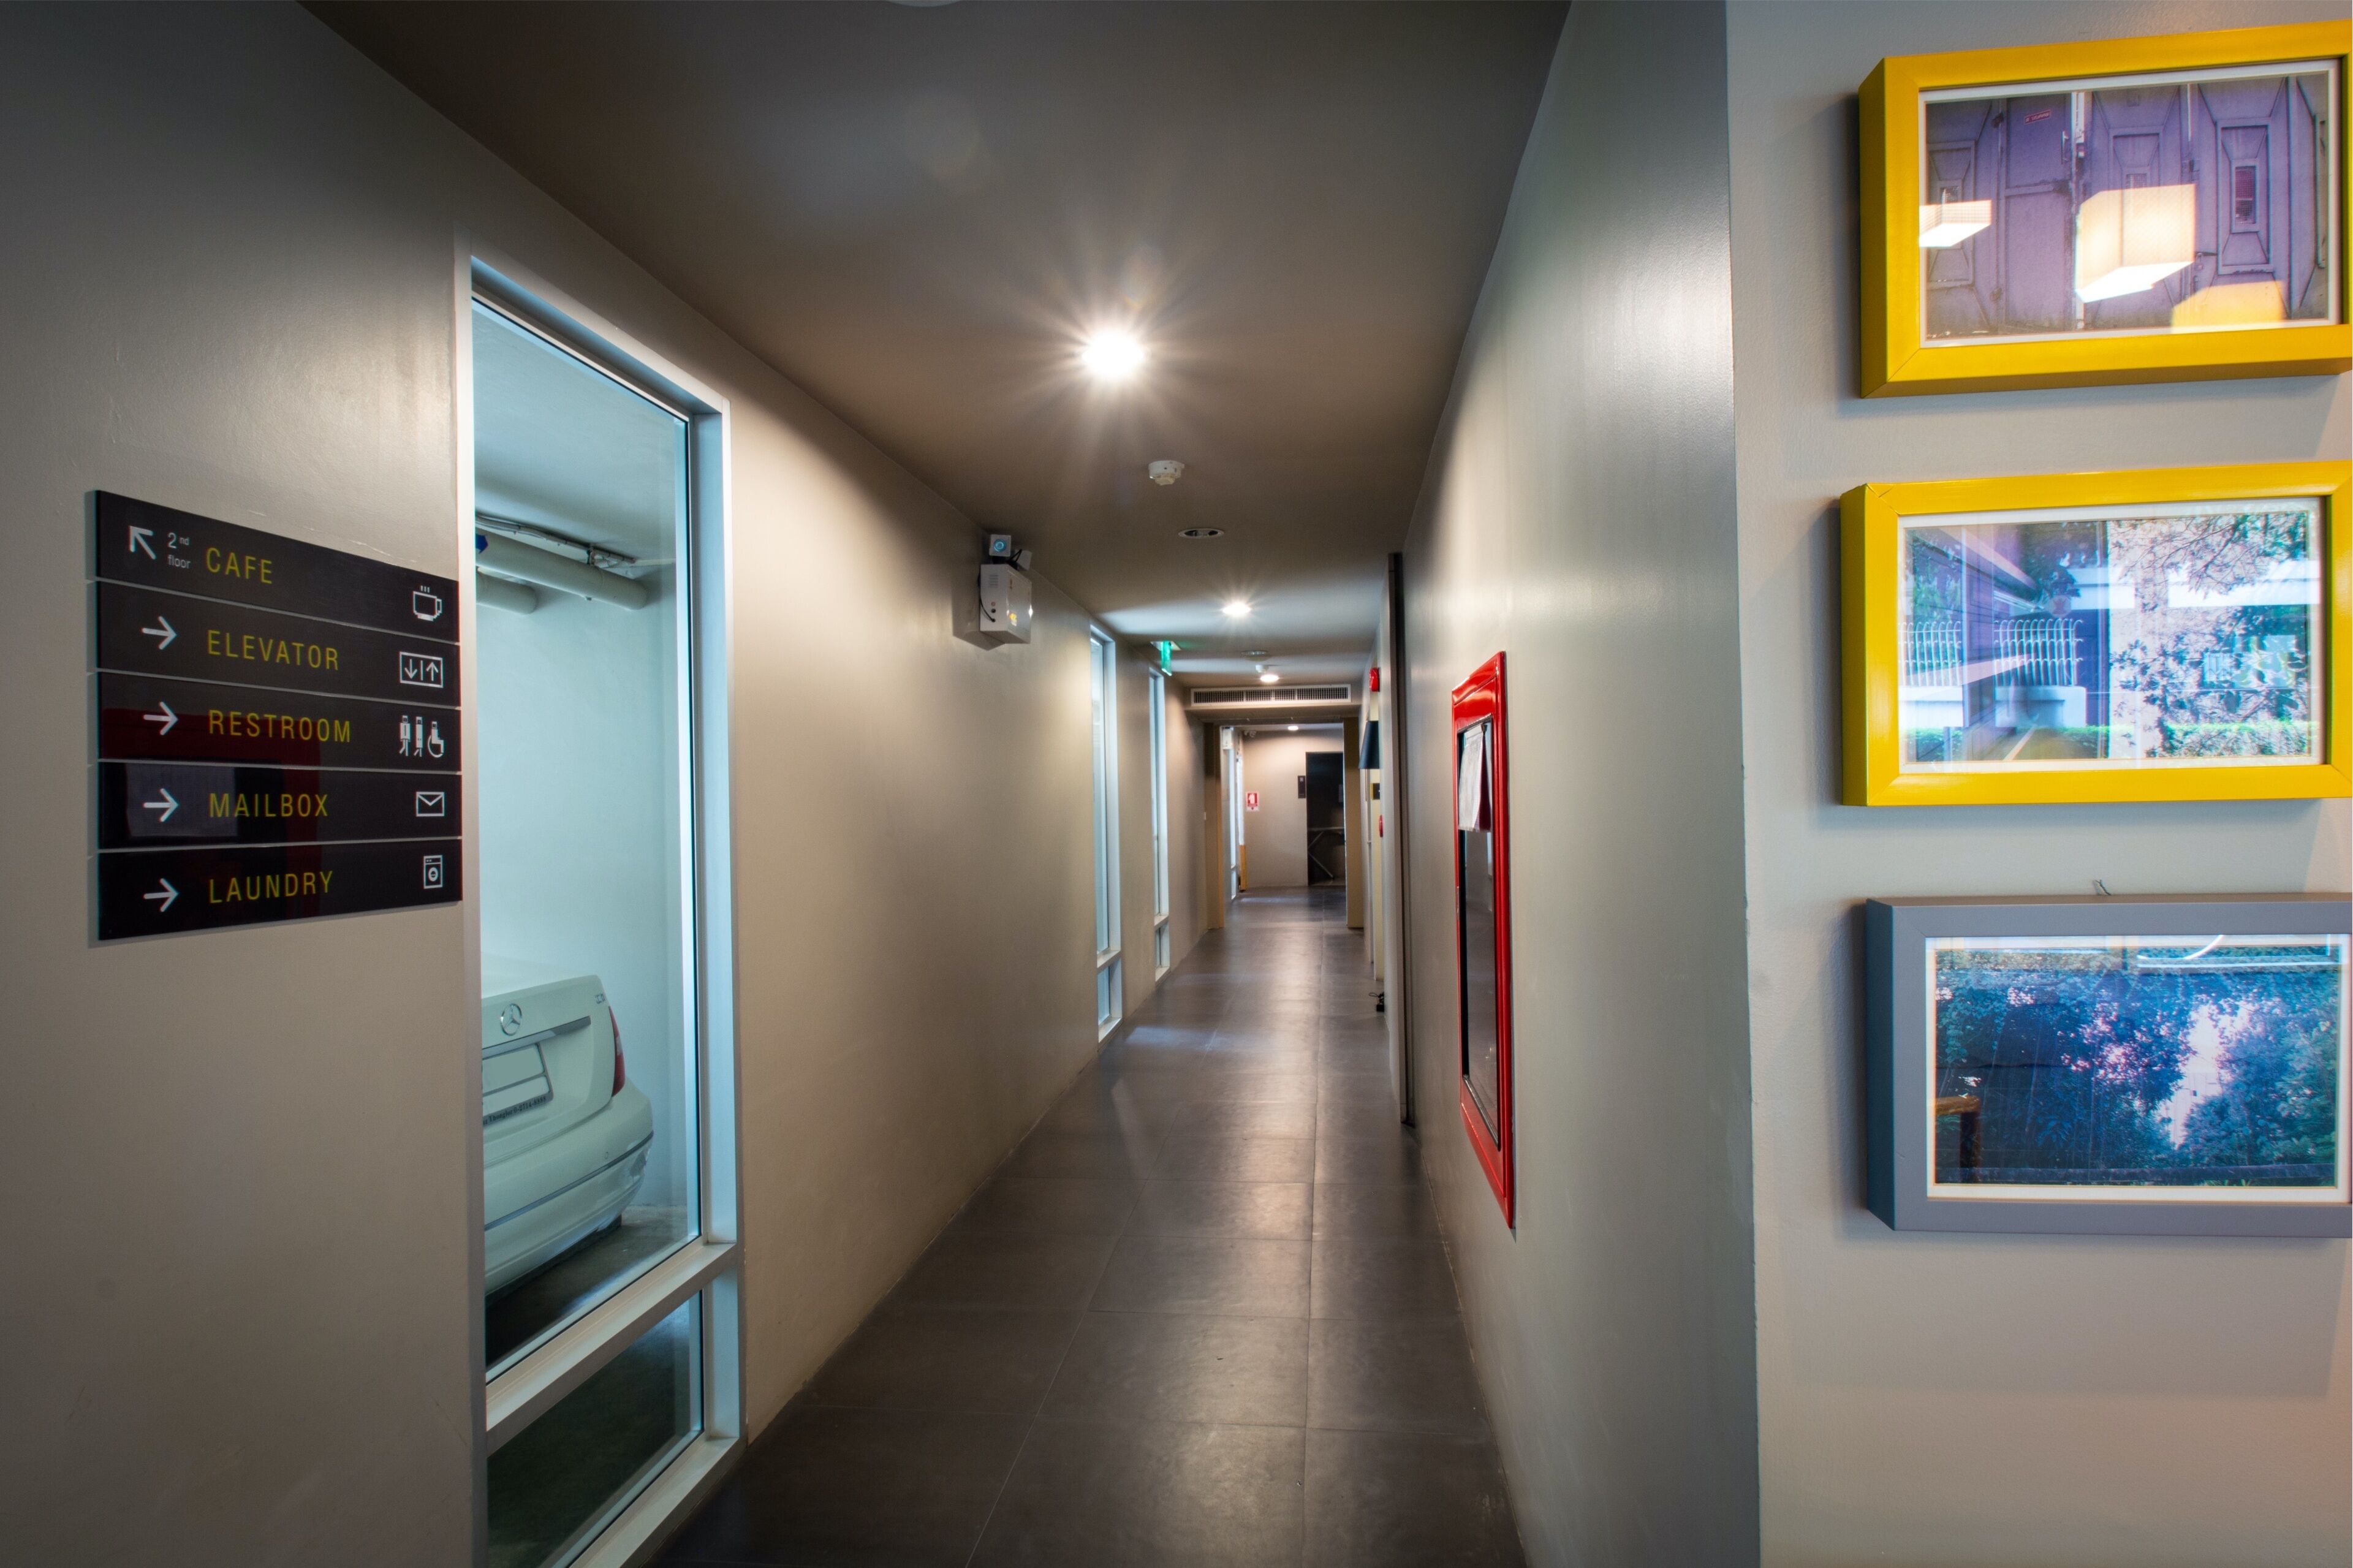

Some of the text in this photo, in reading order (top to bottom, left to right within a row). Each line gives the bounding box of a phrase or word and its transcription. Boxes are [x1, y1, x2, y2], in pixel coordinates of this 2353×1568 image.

[168, 532, 190, 549] 2nd
[167, 554, 191, 569] floor
[206, 547, 273, 585] CAFE
[207, 629, 339, 671] ELEVATOR
[208, 709, 350, 743] RESTROOM
[208, 793, 328, 818] MAILBOX
[208, 870, 333, 904] LAUNDRY
